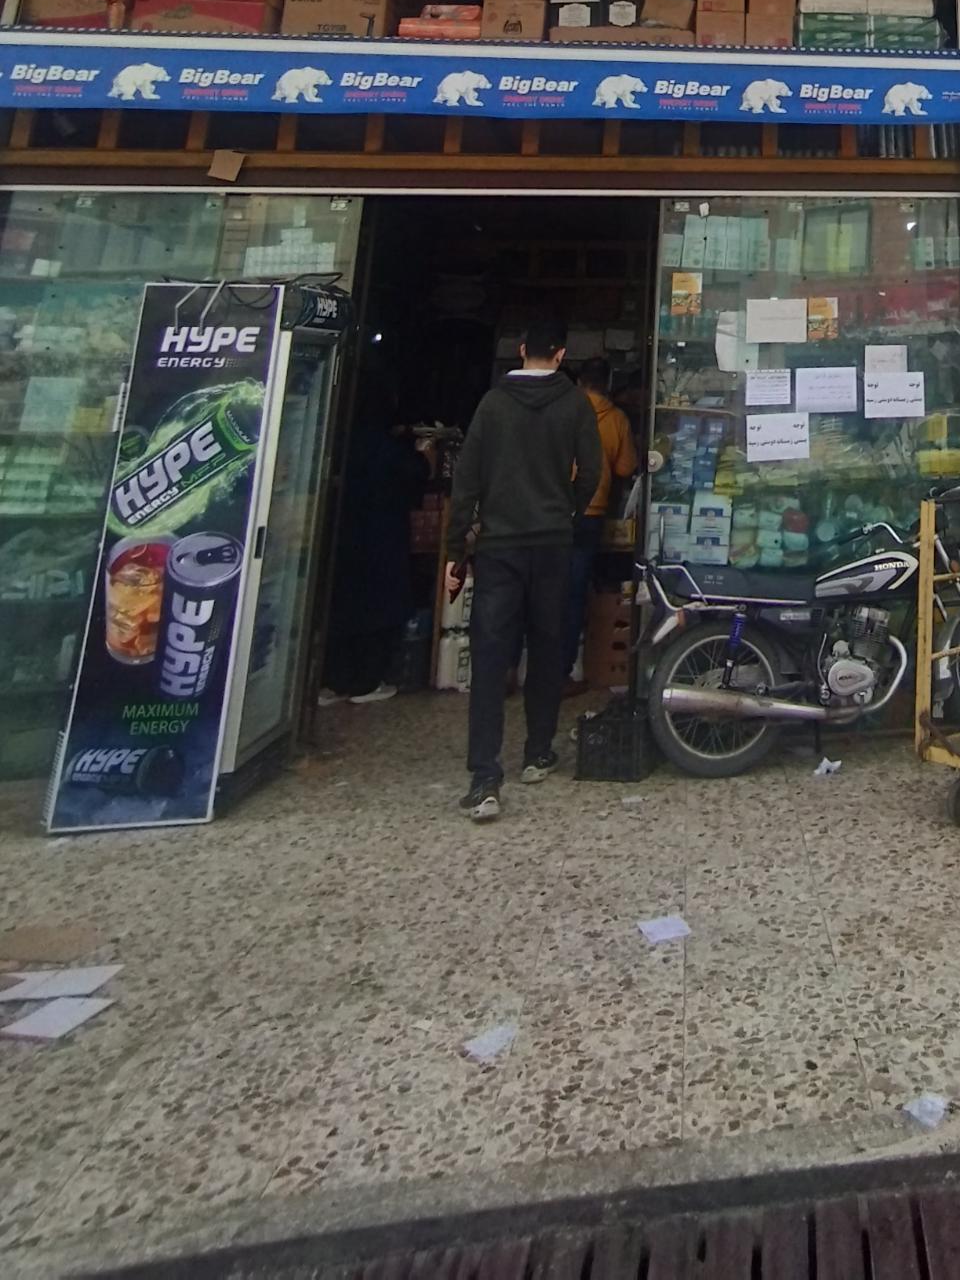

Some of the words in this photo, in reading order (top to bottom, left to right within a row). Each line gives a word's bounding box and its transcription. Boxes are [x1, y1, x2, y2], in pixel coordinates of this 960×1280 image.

[10, 64, 100, 83] BigBear
[178, 68, 265, 87] BigBear
[340, 71, 423, 90] BigBear
[498, 76, 579, 94] BigBear
[654, 80, 732, 98] BigBear
[799, 84, 873, 102] BigBear
[160, 326, 260, 352] HYPE
[157, 357, 226, 368] ENERGY
[115, 421, 222, 519] HYPE
[127, 486, 179, 525] ENERGY
[874, 561, 910, 571] HONDA
[160, 592, 215, 696] HYPE
[122, 702, 200, 719] MAXIMUM
[129, 720, 191, 736] ENERGY
[75, 748, 149, 774] HYPE
